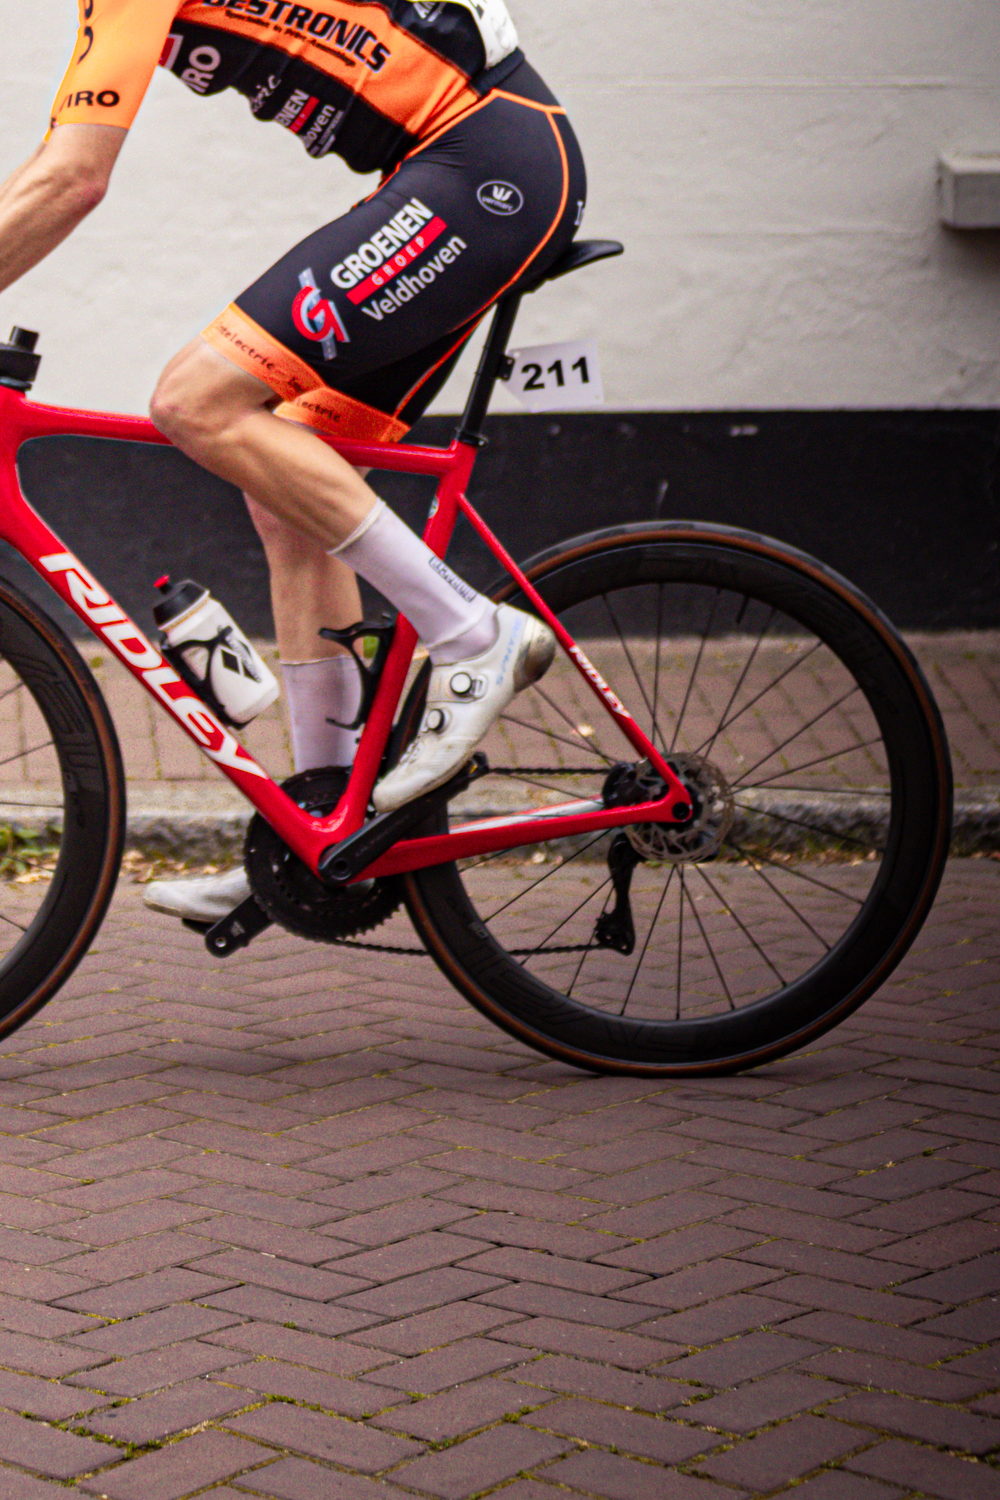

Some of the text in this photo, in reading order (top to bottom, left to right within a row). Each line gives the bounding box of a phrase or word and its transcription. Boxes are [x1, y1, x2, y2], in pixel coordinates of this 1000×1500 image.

[330, 197, 435, 290] GROENEN
[361, 235, 468, 322] Veldhoven
[371, 235, 425, 286] GROEP
[520, 356, 590, 392] 211
[40, 552, 268, 780] RIDLEY
[569, 646, 632, 719] RIDLEY
